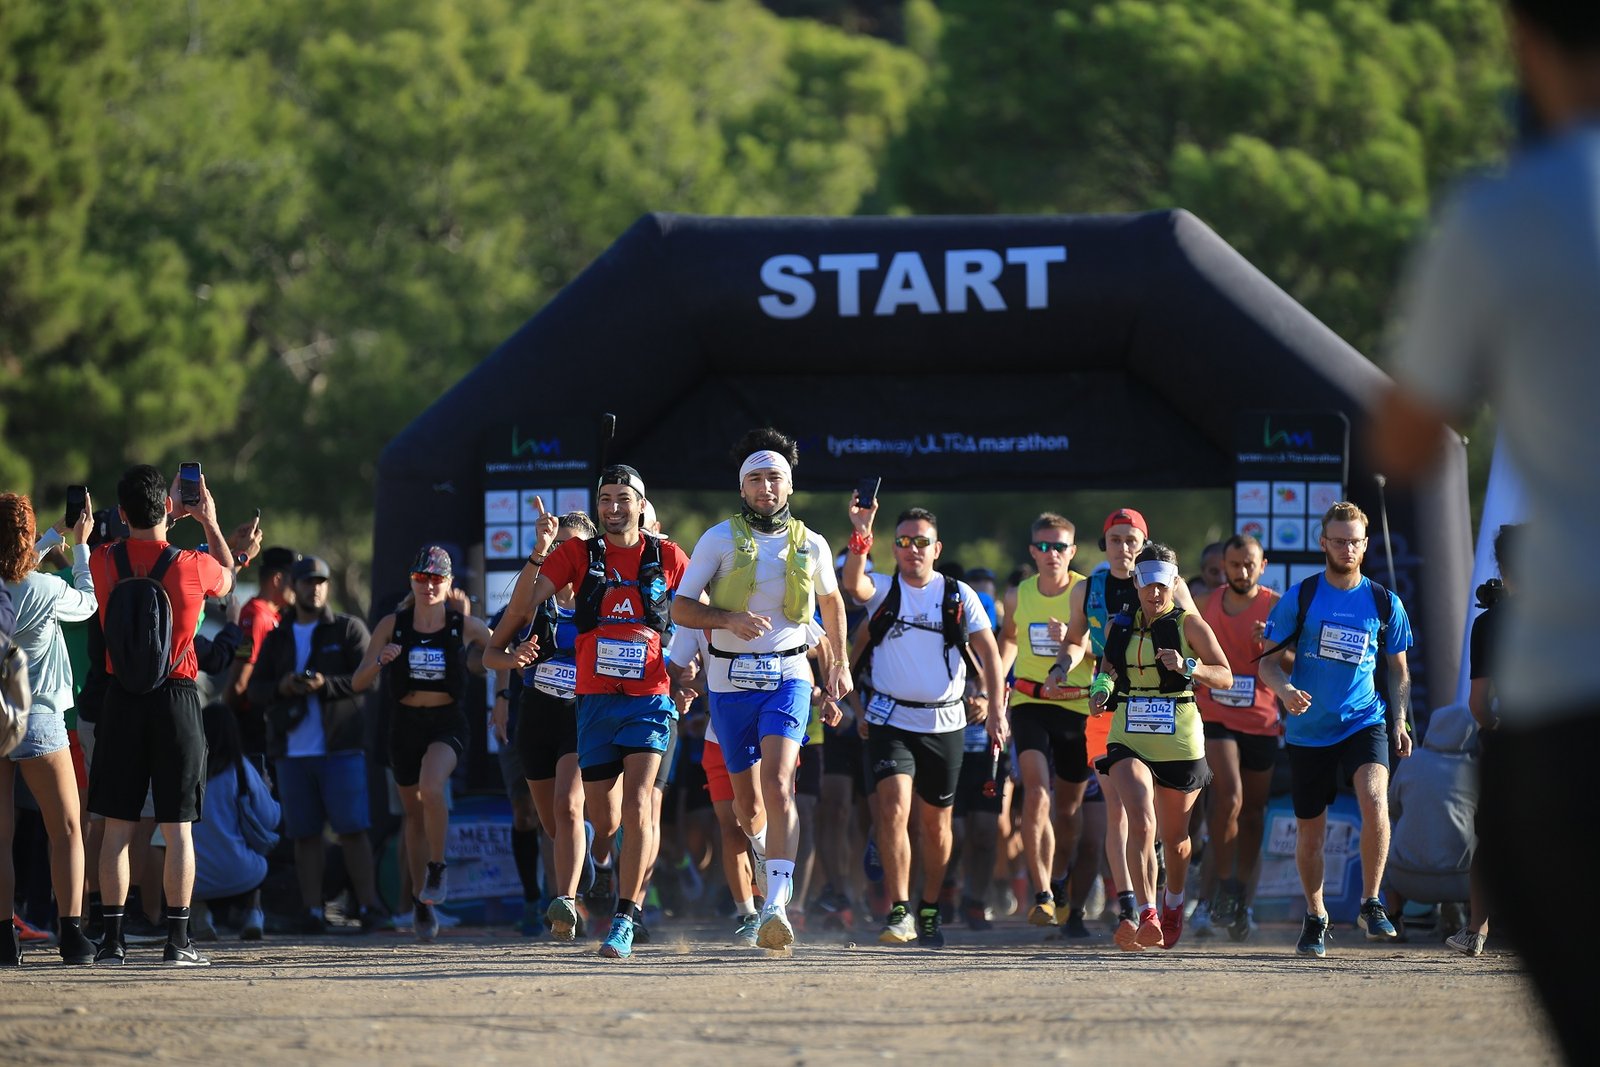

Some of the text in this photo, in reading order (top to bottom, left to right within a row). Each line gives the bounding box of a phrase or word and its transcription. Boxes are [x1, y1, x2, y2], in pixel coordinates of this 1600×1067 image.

[758, 246, 1067, 320] START
[1340, 632, 1366, 645] 2204
[618, 647, 643, 658] 2139
[554, 667, 576, 680] 209
[1144, 703, 1172, 713] 2042
[459, 825, 512, 844] MEET
